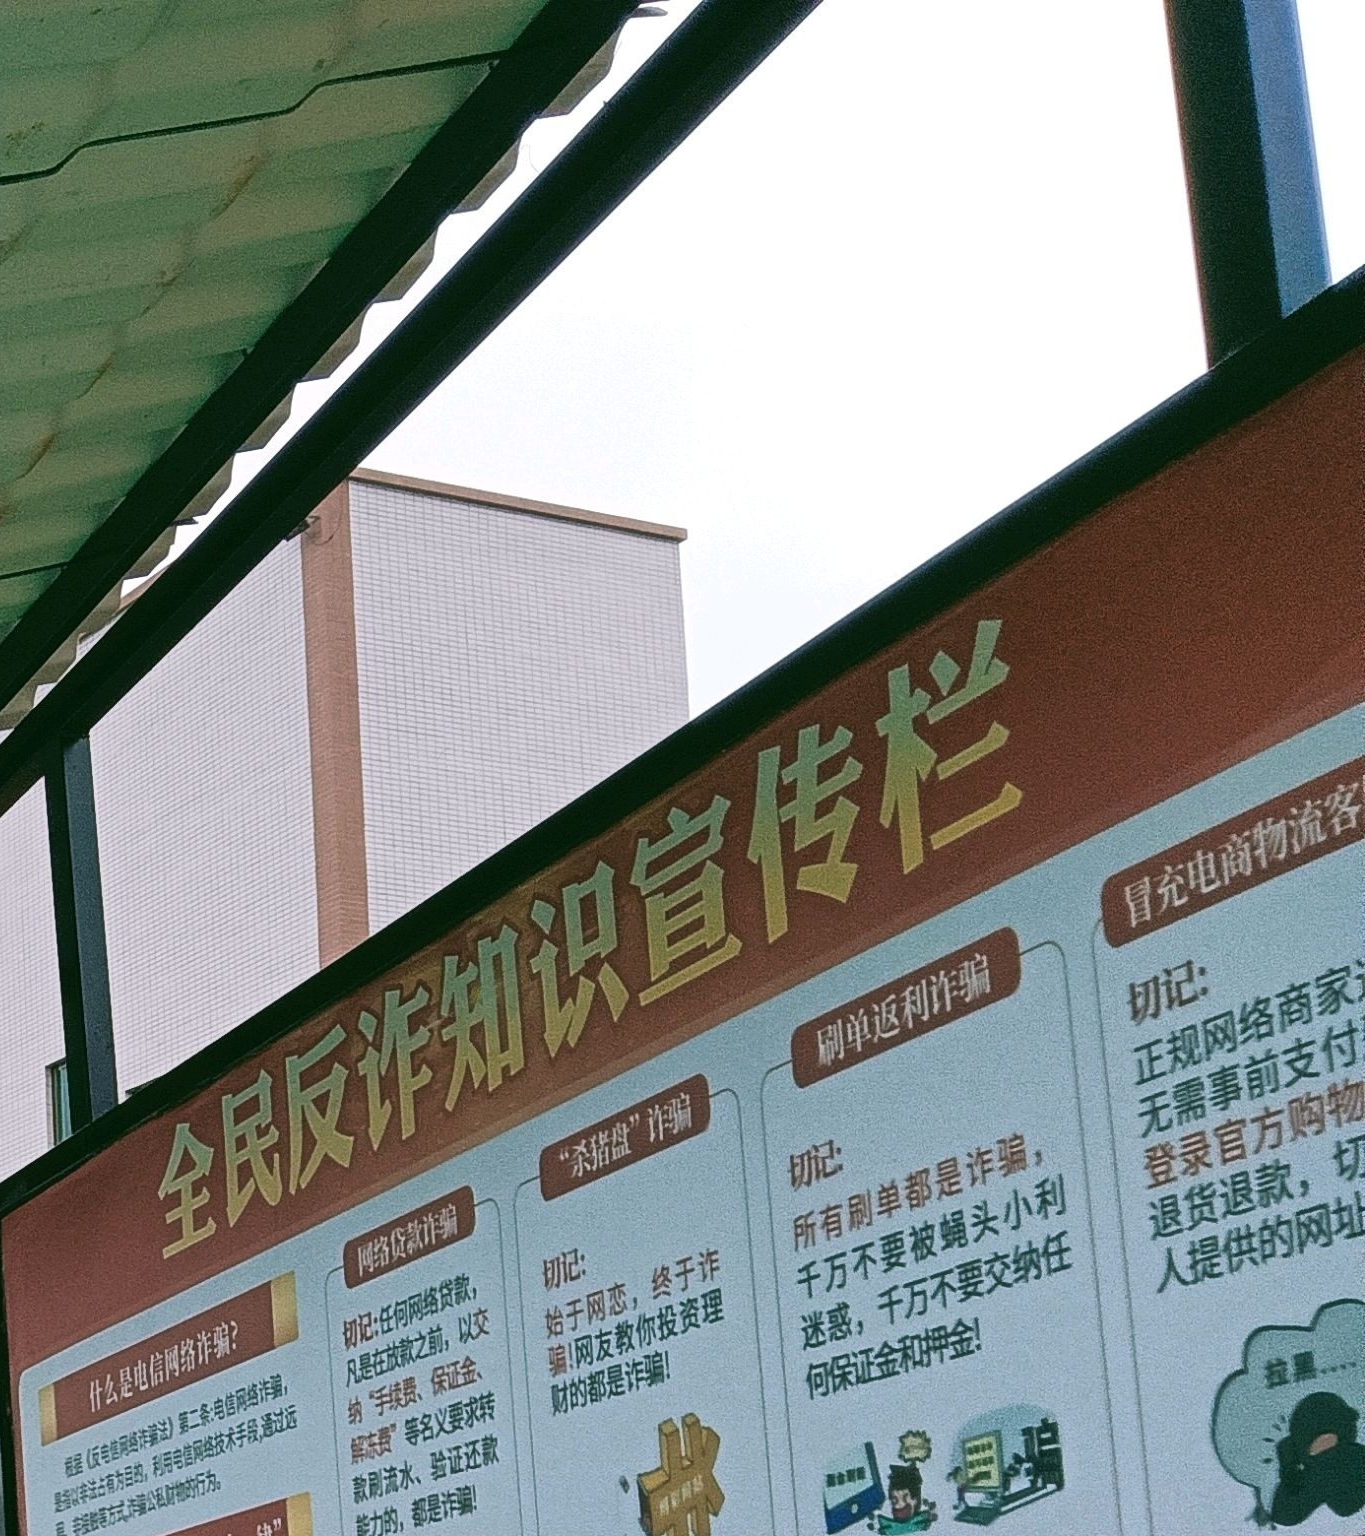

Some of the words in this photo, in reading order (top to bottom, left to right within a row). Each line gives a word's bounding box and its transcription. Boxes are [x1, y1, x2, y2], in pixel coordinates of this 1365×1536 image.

[1124, 775, 1365, 928] 冒充电商物流客
[156, 619, 1024, 1260] 全民反诈知识宣传栏
[816, 953, 991, 1069] 刷单返利诈骗
[1134, 960, 1365, 1086] 正规网络商家
[1137, 1017, 1365, 1139] 无需事前支付
[358, 1204, 458, 1278] 网络贷款诈骗
[797, 1173, 1067, 1299] 千万不要被蝇头小利
